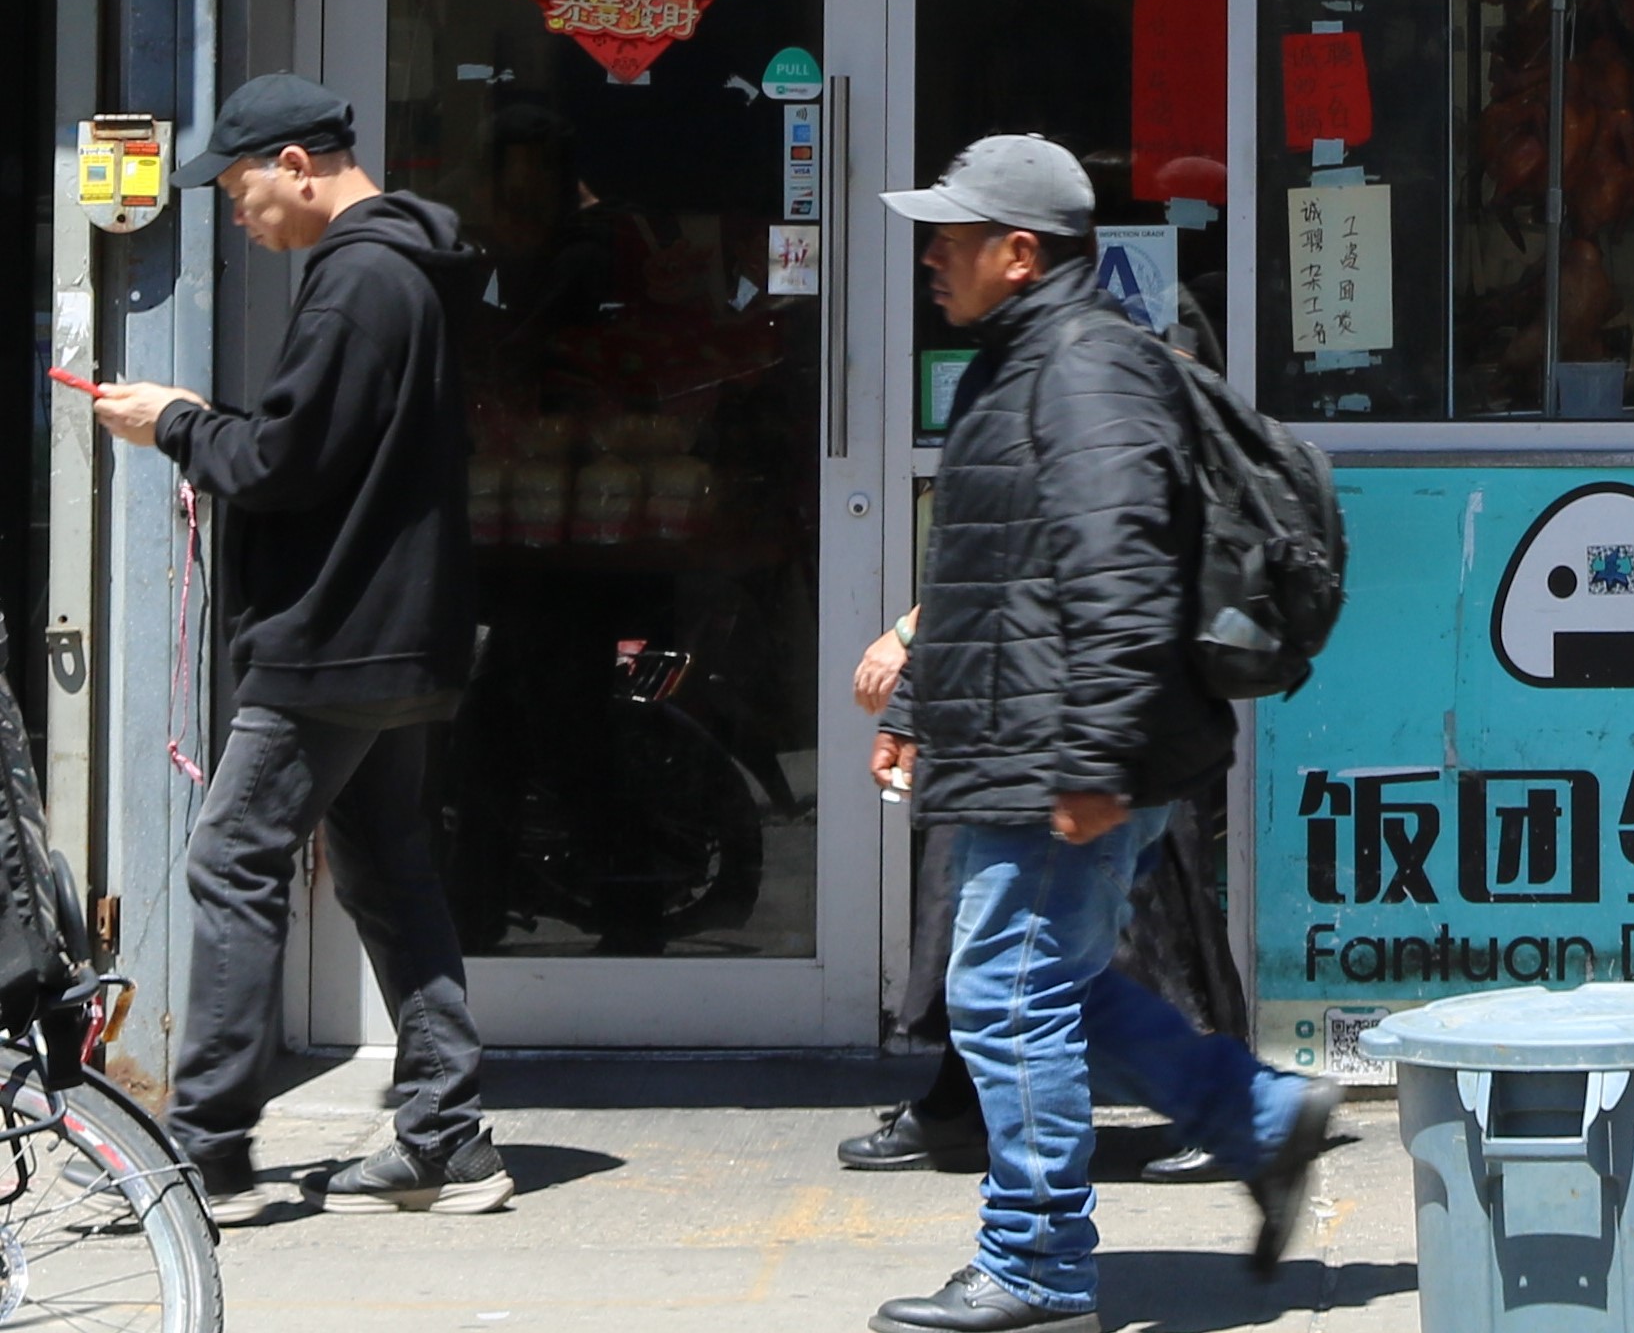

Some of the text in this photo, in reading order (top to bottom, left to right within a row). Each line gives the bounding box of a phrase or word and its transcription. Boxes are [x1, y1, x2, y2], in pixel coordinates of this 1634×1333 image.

[776, 63, 809, 76] PULL
[1141, 229, 1165, 238] GRADE
[1304, 922, 1594, 983] Fantuan
